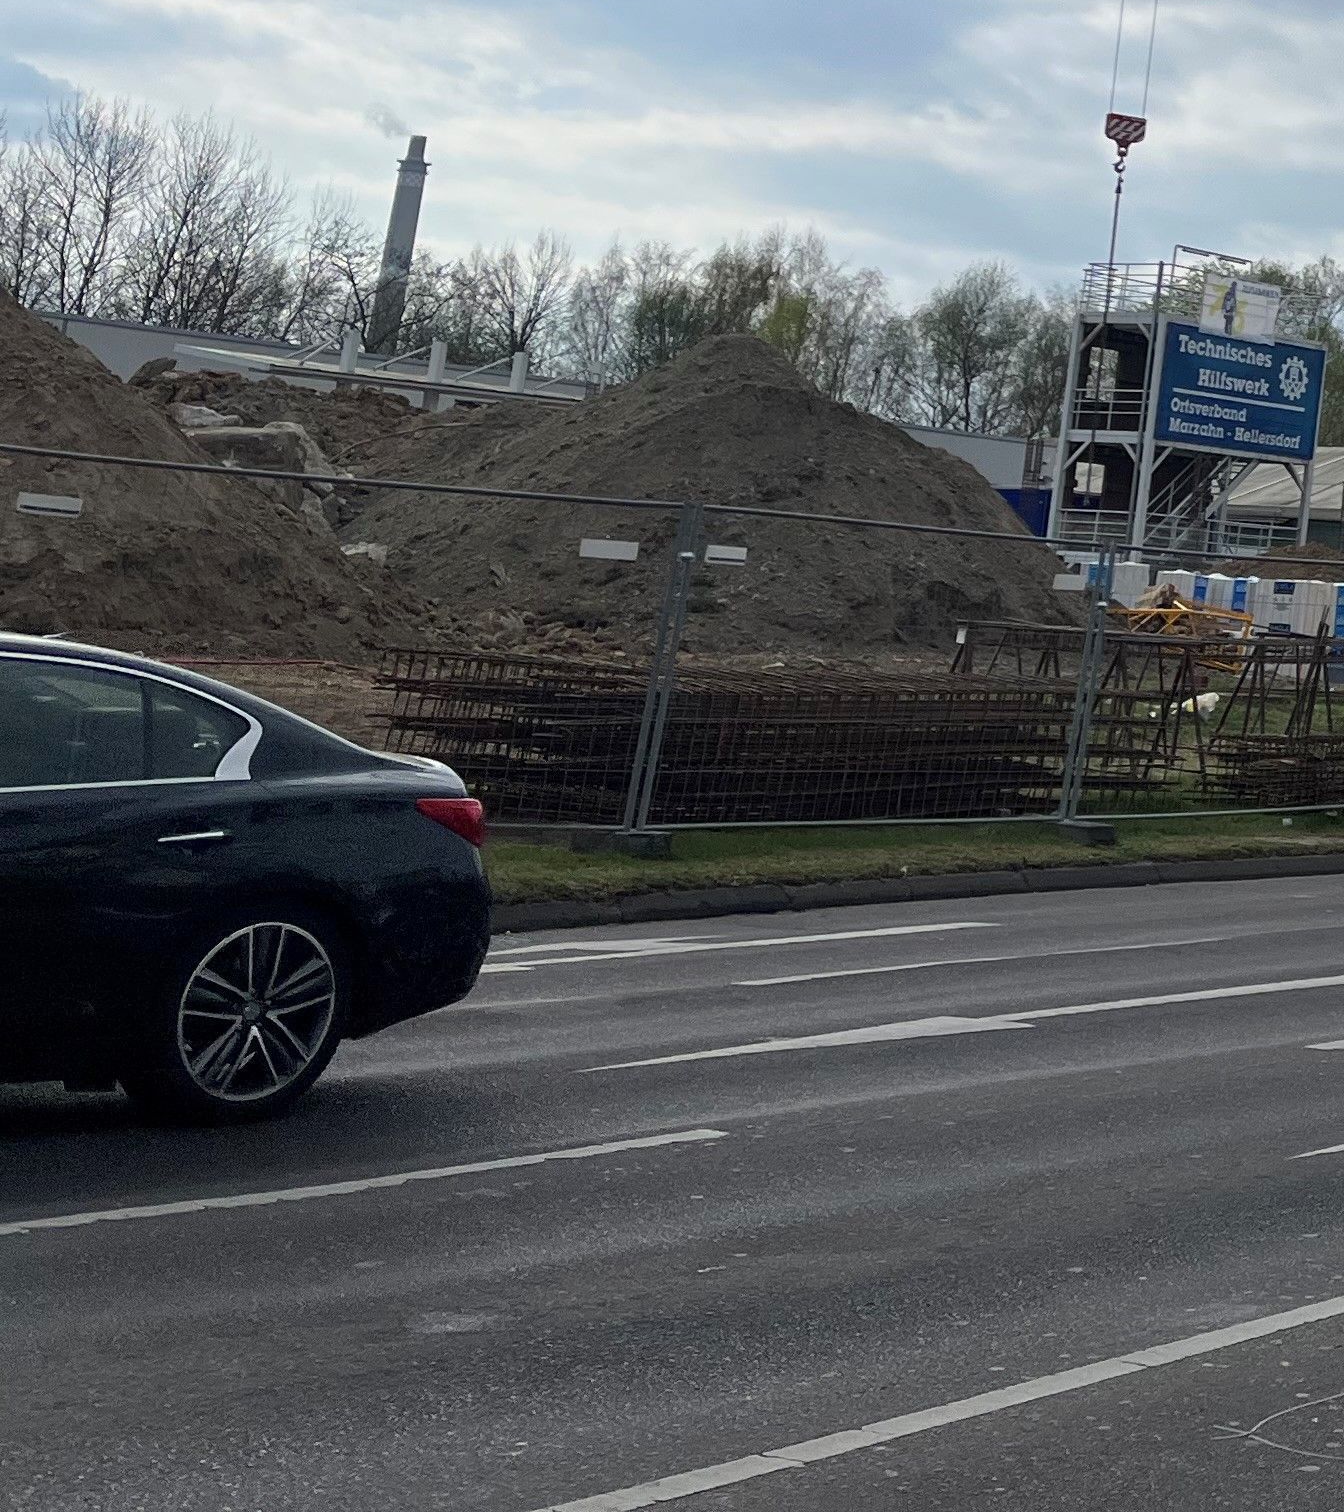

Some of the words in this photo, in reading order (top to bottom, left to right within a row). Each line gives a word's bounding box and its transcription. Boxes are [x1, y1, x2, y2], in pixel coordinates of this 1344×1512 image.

[1178, 333, 1273, 369] Technisches
[1197, 367, 1270, 397] Hilfswerk
[1170, 397, 1247, 423] Ortsverband
[1168, 416, 1225, 439] Marzahn
[1234, 426, 1301, 449] Hellersdorf
